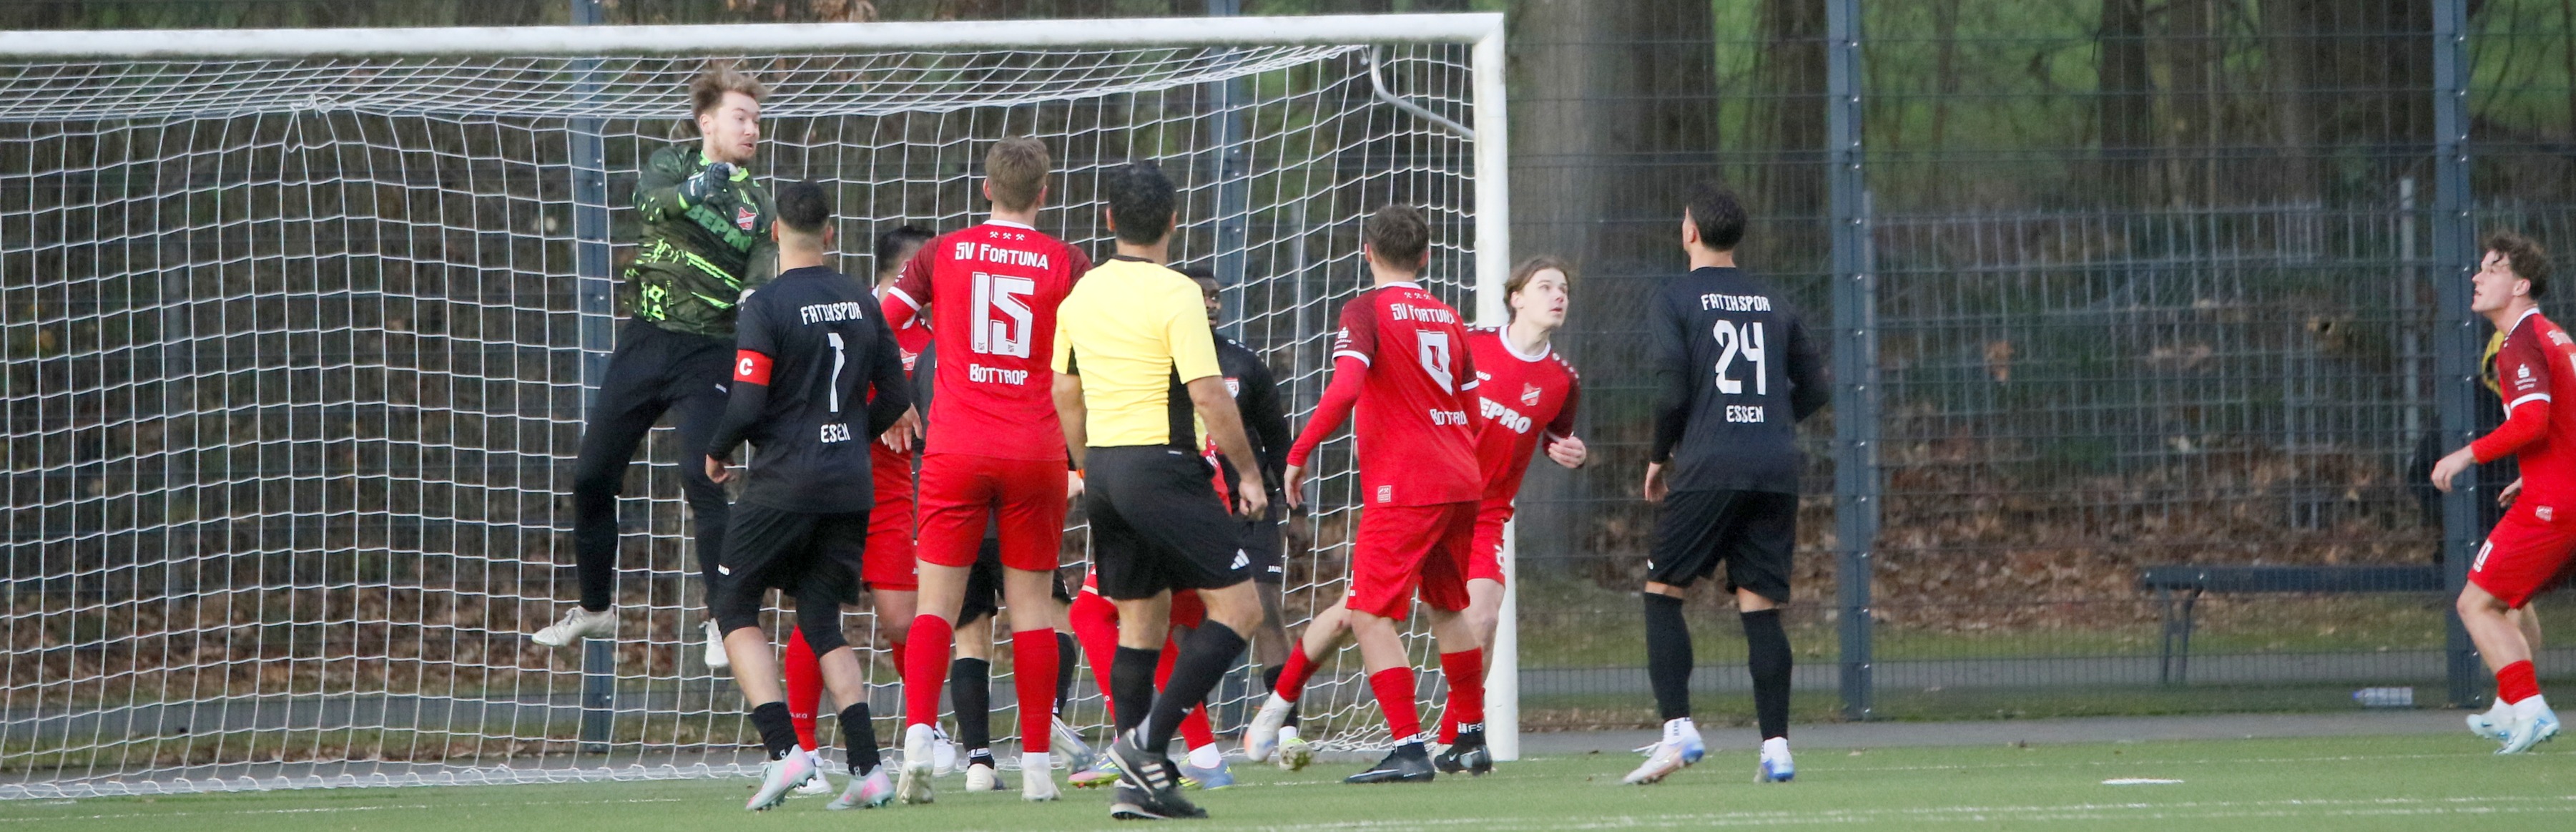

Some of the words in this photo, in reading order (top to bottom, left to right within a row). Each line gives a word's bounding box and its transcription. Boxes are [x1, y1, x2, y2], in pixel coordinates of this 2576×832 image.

[955, 243, 975, 260] SV
[1390, 303, 1408, 320] SV
[1701, 293, 1771, 312] FATIHSPOR
[971, 271, 1035, 358] 15
[1713, 319, 1766, 395] 24
[739, 358, 754, 376] C
[1479, 396, 1532, 434] EPRO
[1726, 405, 1764, 423] ESSEN
